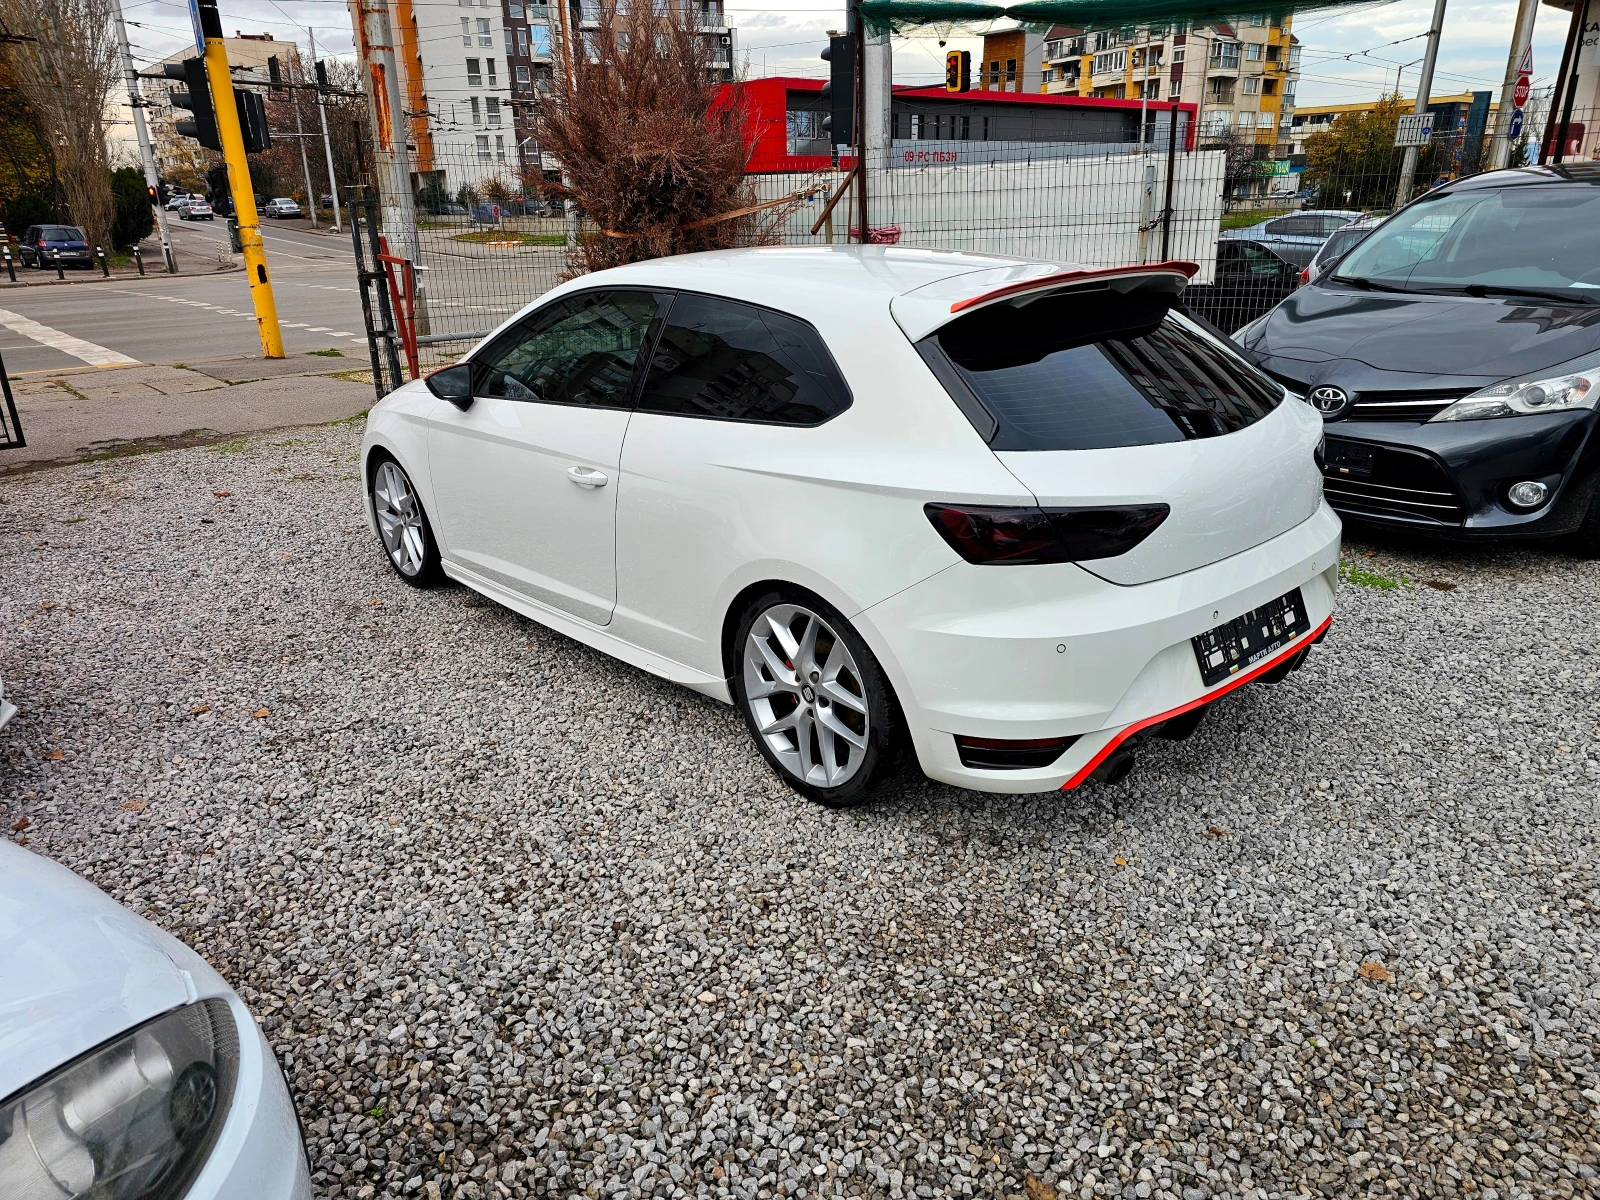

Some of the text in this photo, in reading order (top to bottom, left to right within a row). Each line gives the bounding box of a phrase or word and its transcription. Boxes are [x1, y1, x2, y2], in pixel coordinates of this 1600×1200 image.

[1514, 86, 1529, 98] STOP
[904, 150, 957, 162] 09 РС ПБЗН
[1248, 648, 1268, 664] МАРТИ
